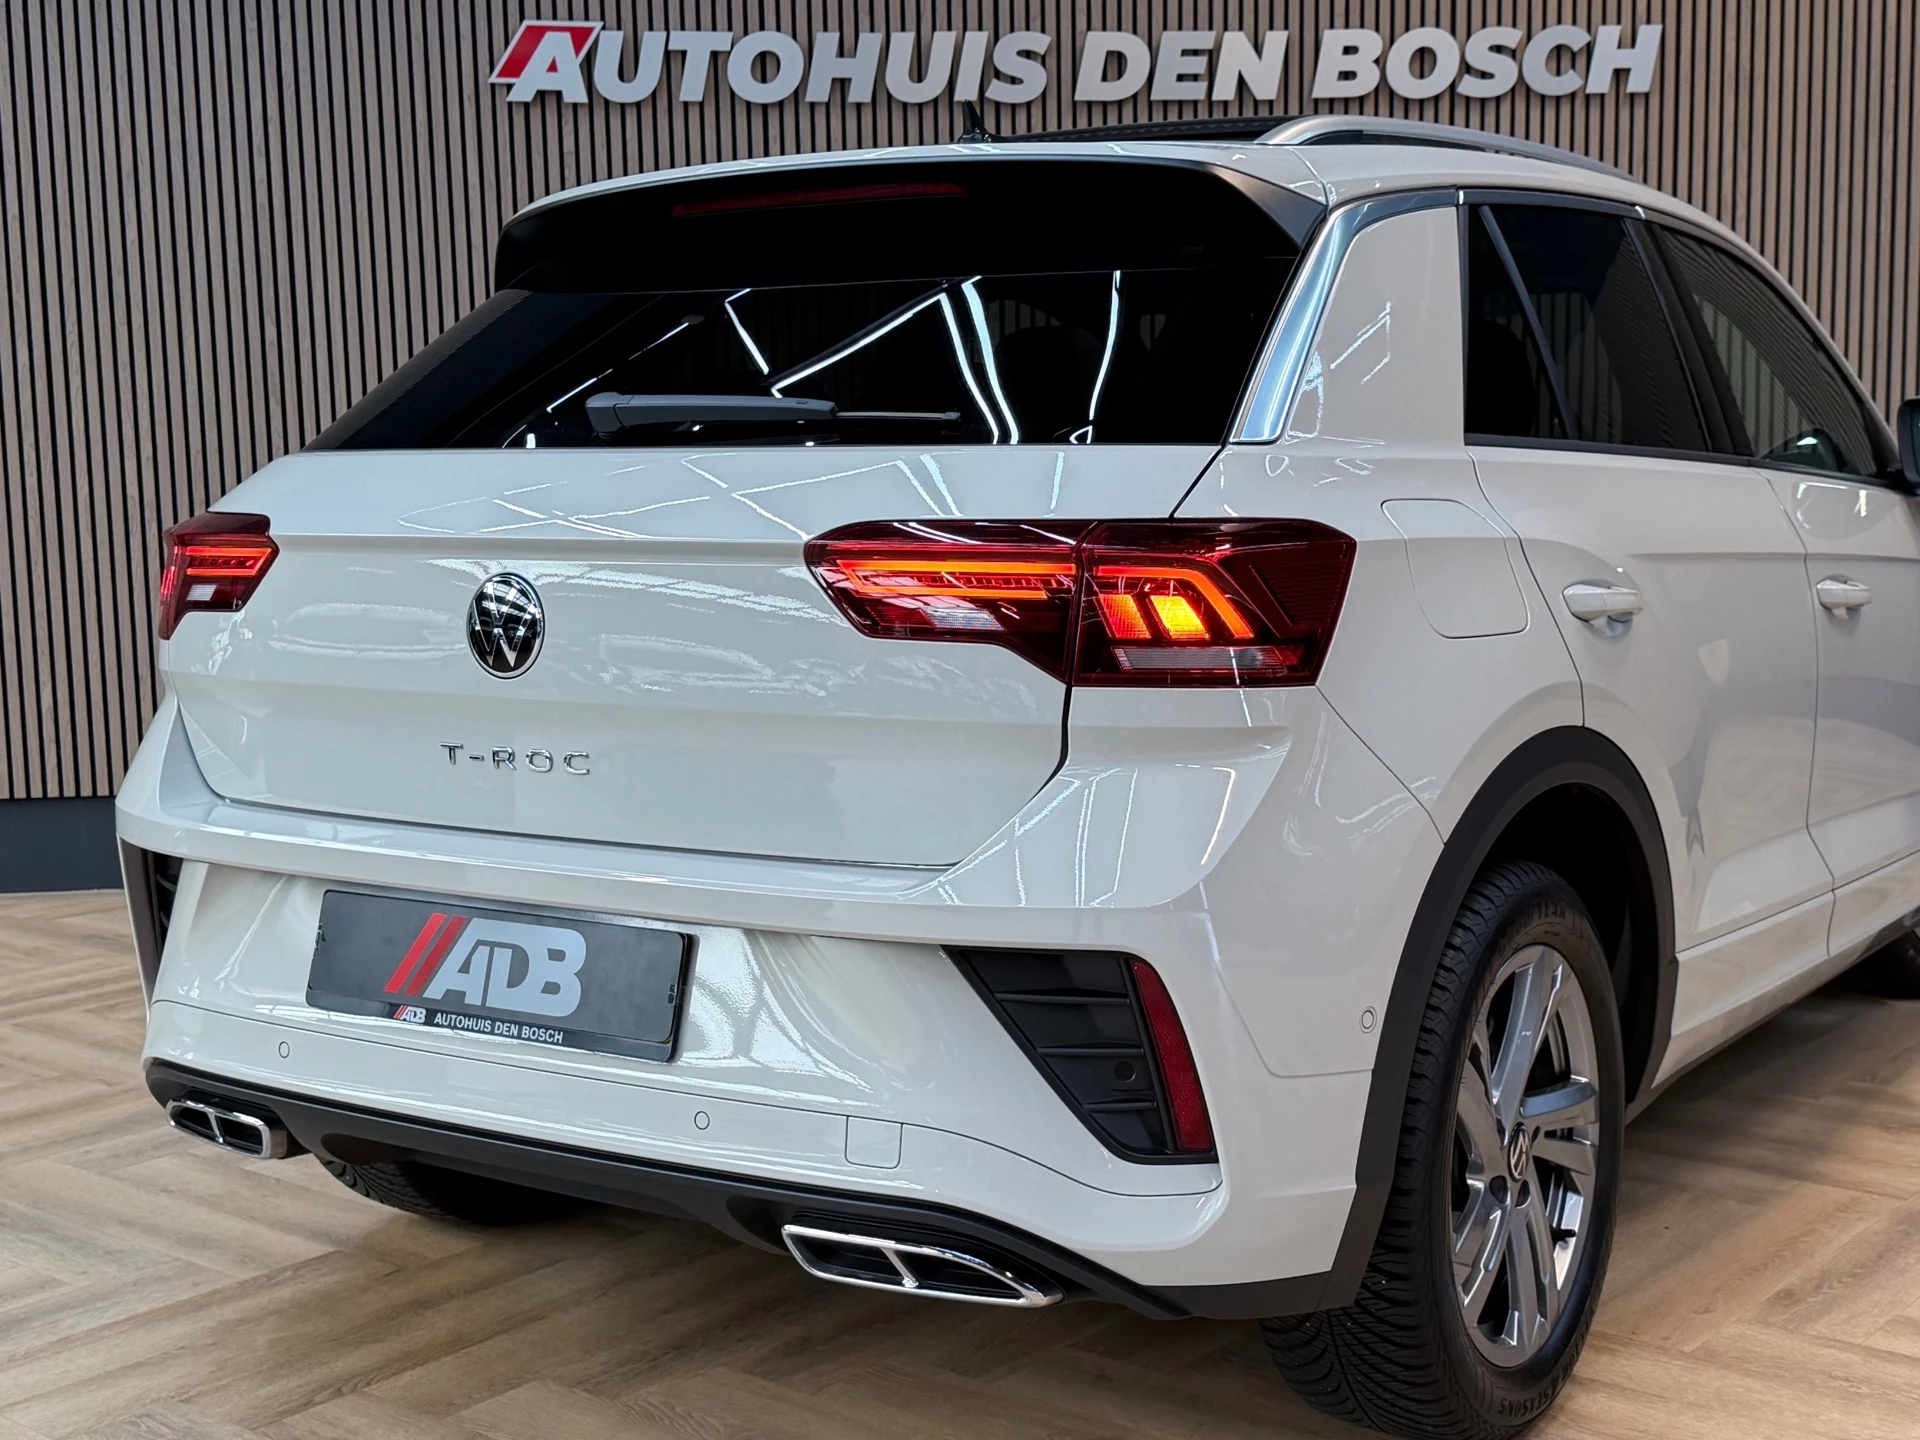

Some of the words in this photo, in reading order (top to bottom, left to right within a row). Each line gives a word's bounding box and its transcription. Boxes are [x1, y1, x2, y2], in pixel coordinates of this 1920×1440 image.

[506, 29, 1052, 105] AUTOHUIS
[1074, 30, 1289, 101] DEN
[1311, 24, 1663, 99] BOSCH
[440, 742, 590, 775] T-ROC
[422, 918, 587, 1017] ADB
[434, 1012, 492, 1032] AUTOHUIS
[494, 1021, 519, 1037] DEN
[521, 1025, 564, 1044] BOSCH
